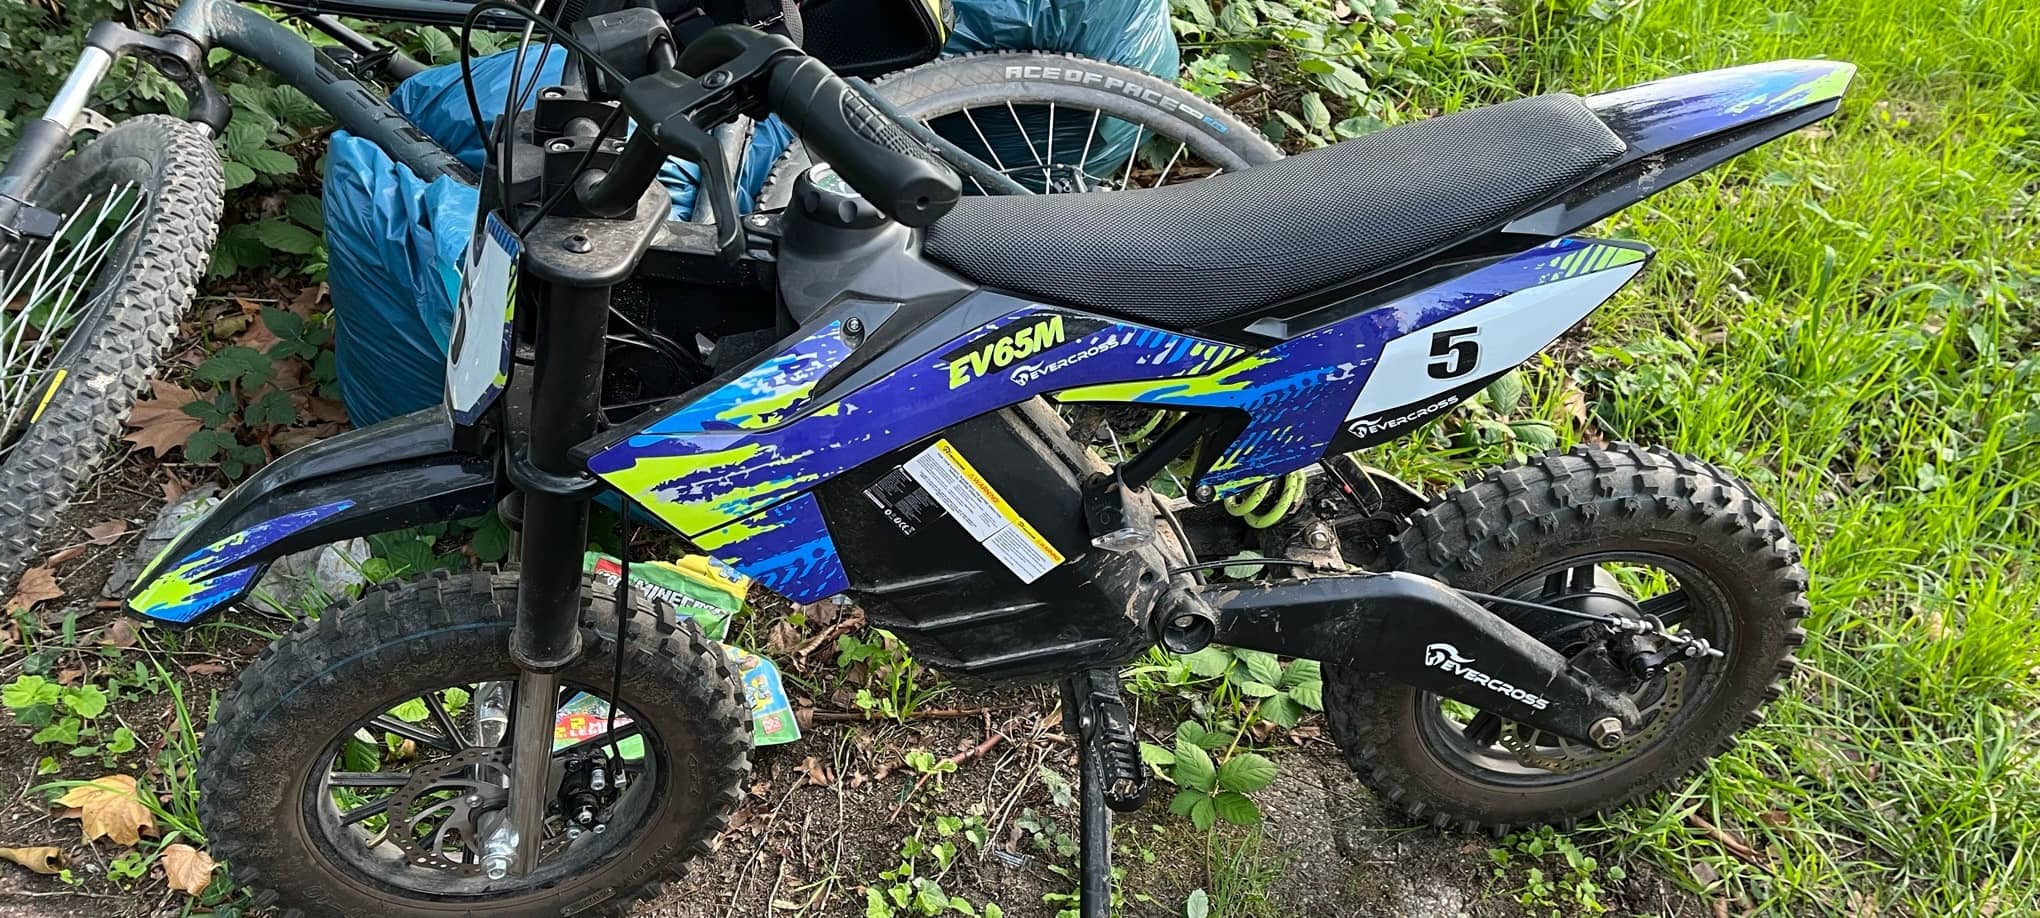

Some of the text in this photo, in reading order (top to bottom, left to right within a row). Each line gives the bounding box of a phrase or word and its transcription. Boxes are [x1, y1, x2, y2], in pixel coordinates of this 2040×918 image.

[1005, 66, 1179, 111] ACE OF PACE
[949, 315, 1065, 390] EV65M
[1030, 339, 1119, 380] EVERCROSS
[1428, 326, 1479, 379] 5
[1369, 395, 1458, 434] EVERCROSS
[1440, 660, 1550, 710] EVERCROSS
